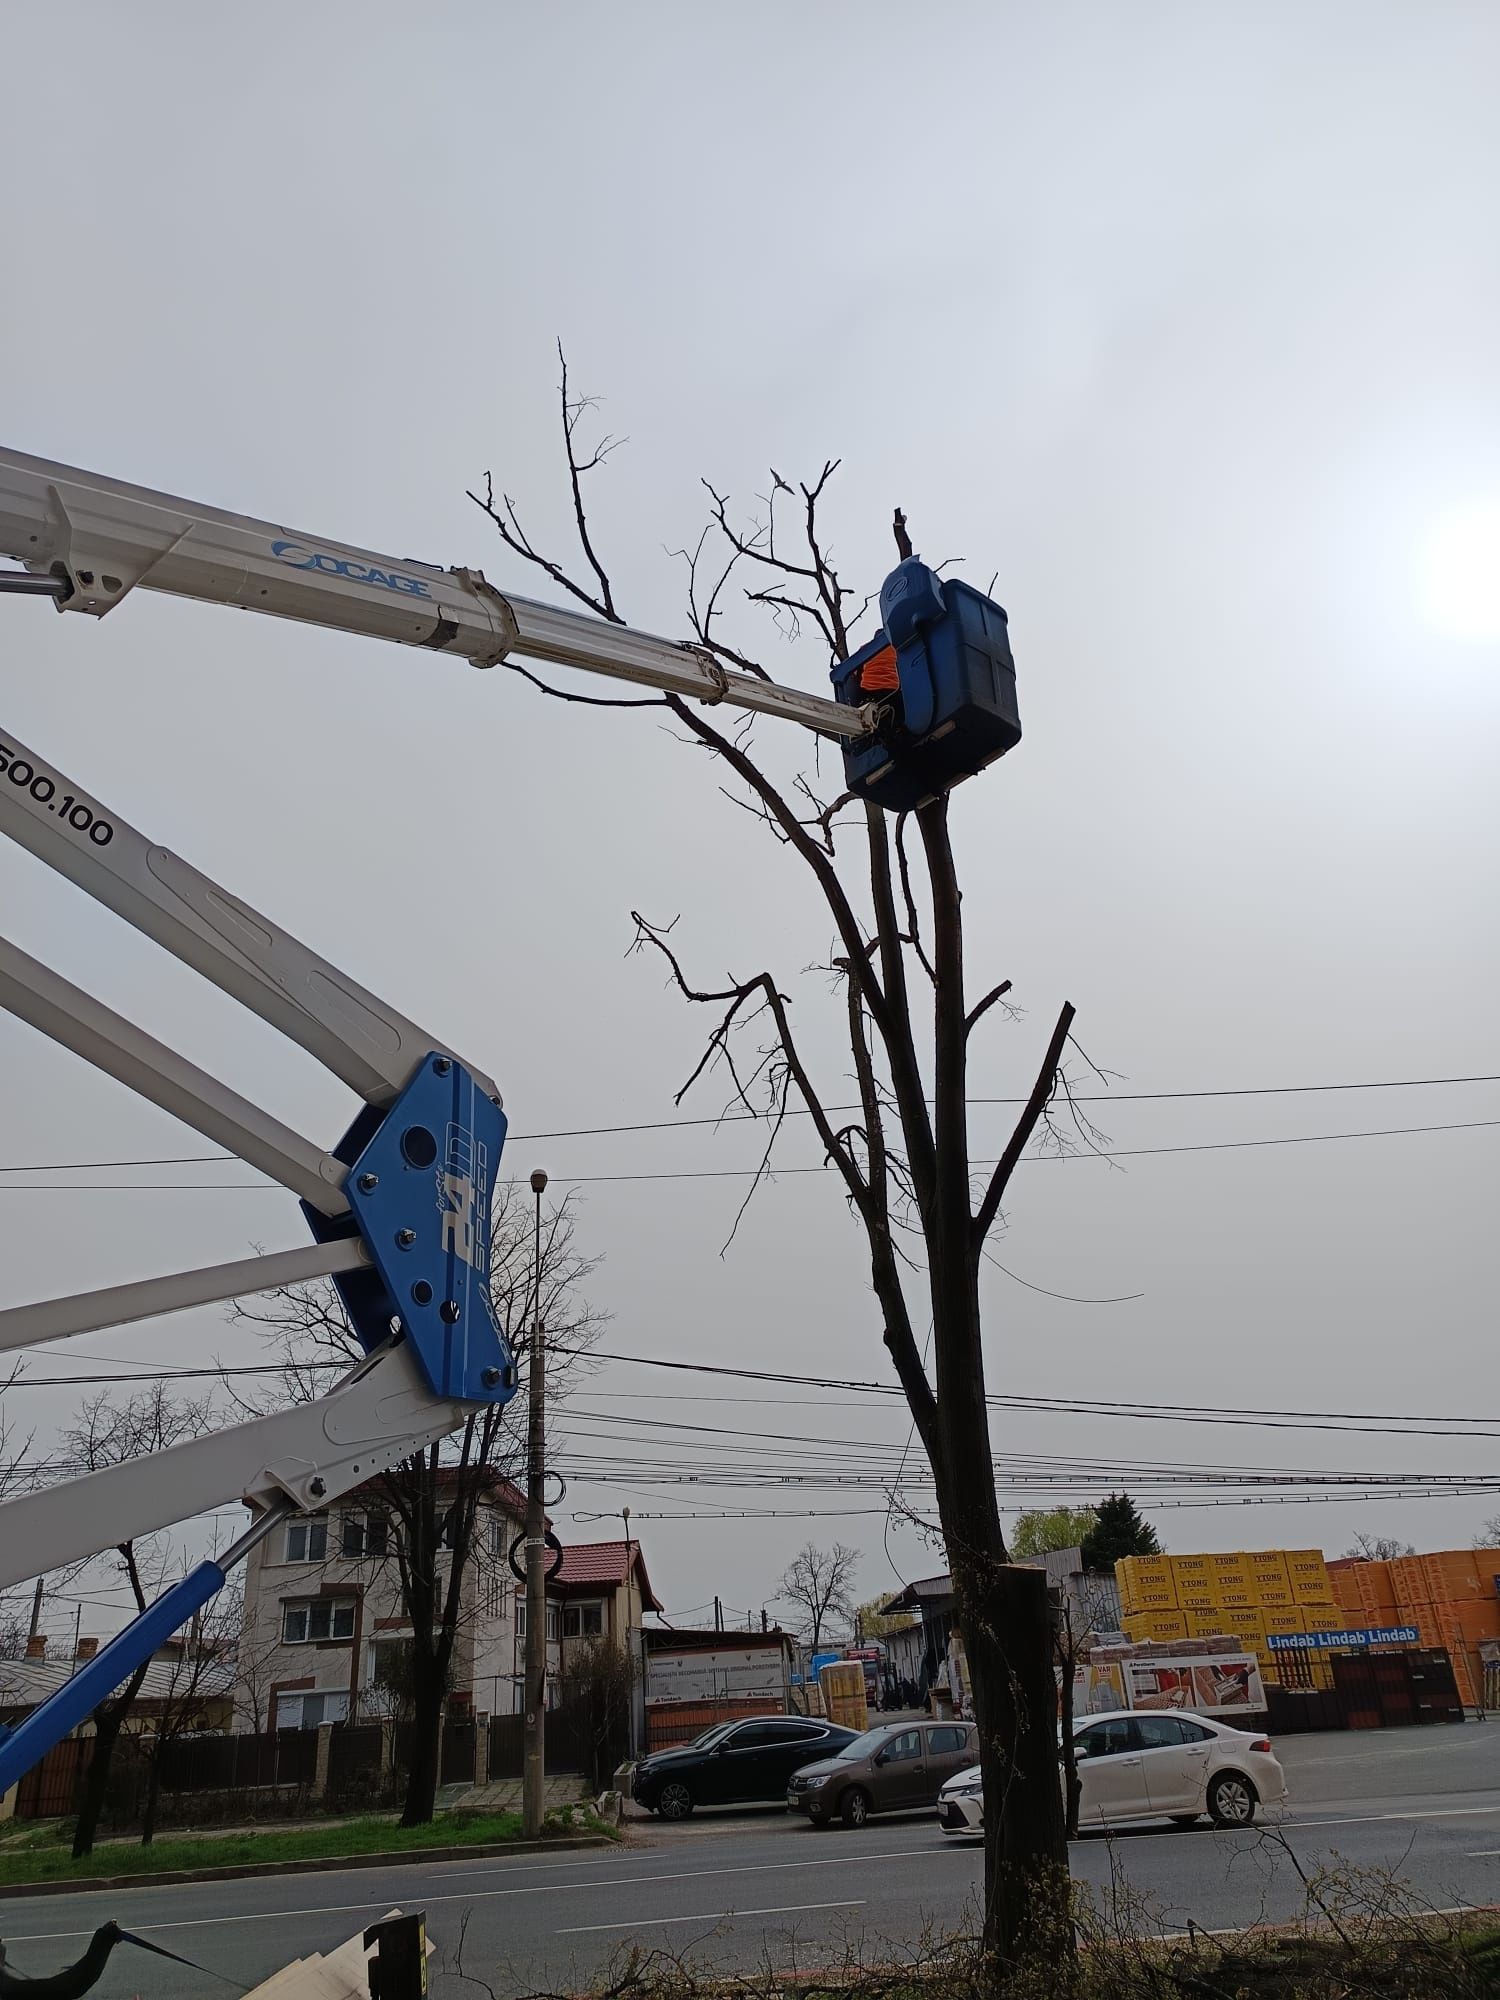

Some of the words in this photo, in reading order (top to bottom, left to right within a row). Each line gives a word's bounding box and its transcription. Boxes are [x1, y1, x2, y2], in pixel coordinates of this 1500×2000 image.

[271, 539, 432, 598] SOCAGE
[476, 1140, 488, 1274] SPEED
[1137, 1556, 1161, 1565] YTONG
[1214, 1557, 1239, 1565] YTONG
[1252, 1554, 1277, 1563] YTONG
[1177, 1561, 1204, 1569] YTONG
[1294, 1563, 1320, 1572] YTONG
[1139, 1575, 1167, 1584] YTONG
[1218, 1576, 1244, 1584] YTONG
[1256, 1574, 1282, 1582] YTONG
[1180, 1579, 1208, 1588] YTONG
[1297, 1583, 1325, 1591] YTONG
[1142, 1594, 1170, 1602] YTONG
[1222, 1594, 1248, 1603] YTONG
[1260, 1593, 1287, 1601] YTONG
[1184, 1598, 1211, 1606] YTONG
[1230, 1614, 1257, 1622] YTONG
[1271, 1617, 1297, 1625] YTONG
[1153, 1622, 1181, 1631] YTONG
[1311, 1620, 1338, 1628] YTONG
[1195, 1628, 1223, 1636] YTONG
[1267, 1634, 1315, 1649] Lindab
[1318, 1631, 1366, 1646] Lindab
[1368, 1627, 1416, 1643] Lindab
